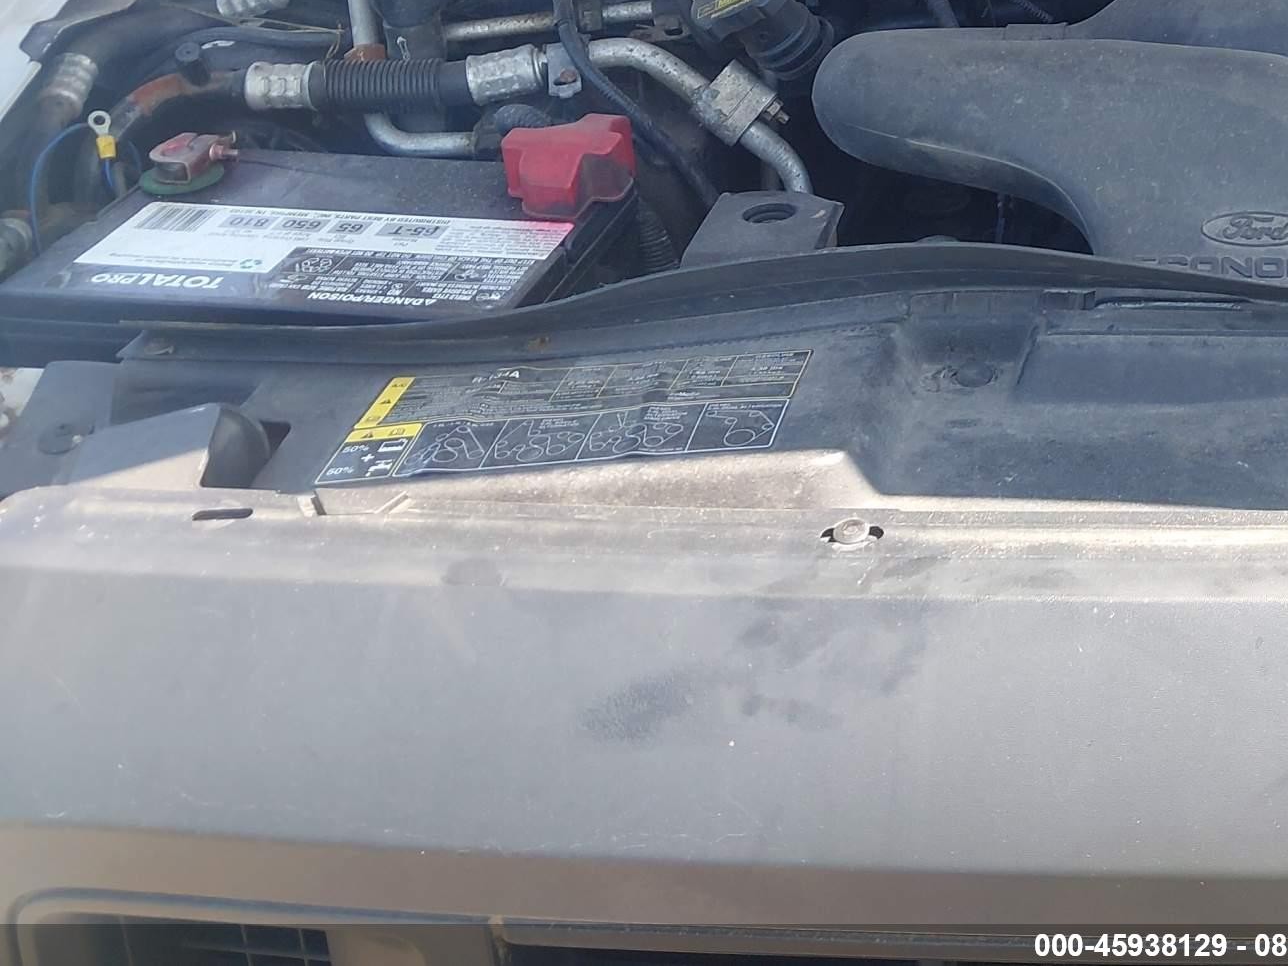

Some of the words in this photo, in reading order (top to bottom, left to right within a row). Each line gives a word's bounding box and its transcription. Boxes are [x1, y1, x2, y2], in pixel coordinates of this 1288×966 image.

[229, 216, 269, 227] 810
[282, 219, 321, 230] 650
[338, 223, 363, 233] 65
[389, 225, 440, 237] 65-T
